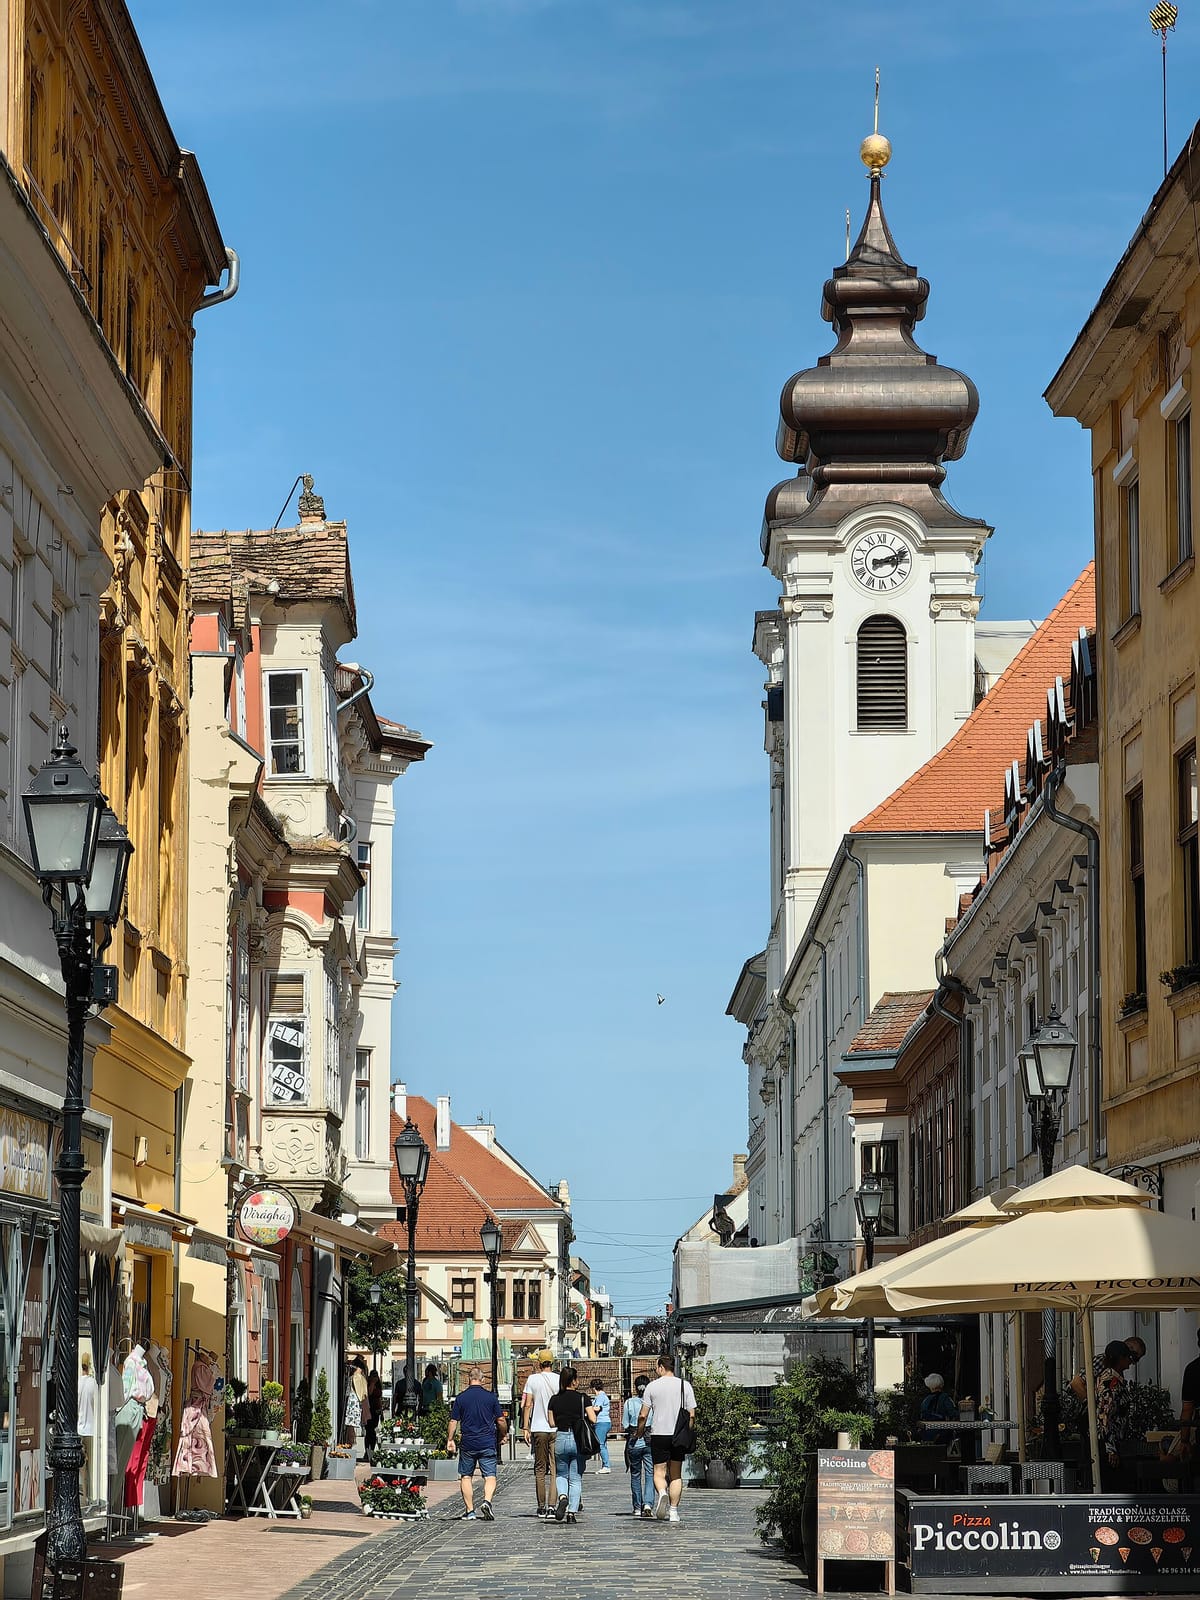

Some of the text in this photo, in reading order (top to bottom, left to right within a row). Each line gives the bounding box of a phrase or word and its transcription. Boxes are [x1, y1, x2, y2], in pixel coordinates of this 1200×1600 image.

[864, 536, 875, 548] XI
[877, 534, 886, 544] XII
[890, 536, 896, 546] I
[856, 546, 867, 555] X
[879, 580, 886, 589] VI
[890, 578, 897, 587] V
[273, 1024, 300, 1046] ELA
[275, 1067, 304, 1090] 180
[243, 1206, 291, 1224] Virágház
[1012, 1281, 1078, 1293] PIZZA
[820, 1458, 867, 1468] Piccolino
[1159, 1507, 1187, 1515] OLASZ
[952, 1513, 992, 1527] Pizza
[1088, 1515, 1191, 1523] PIZZA & PIZZASZELETEK
[913, 1521, 1062, 1551] Piccolino
